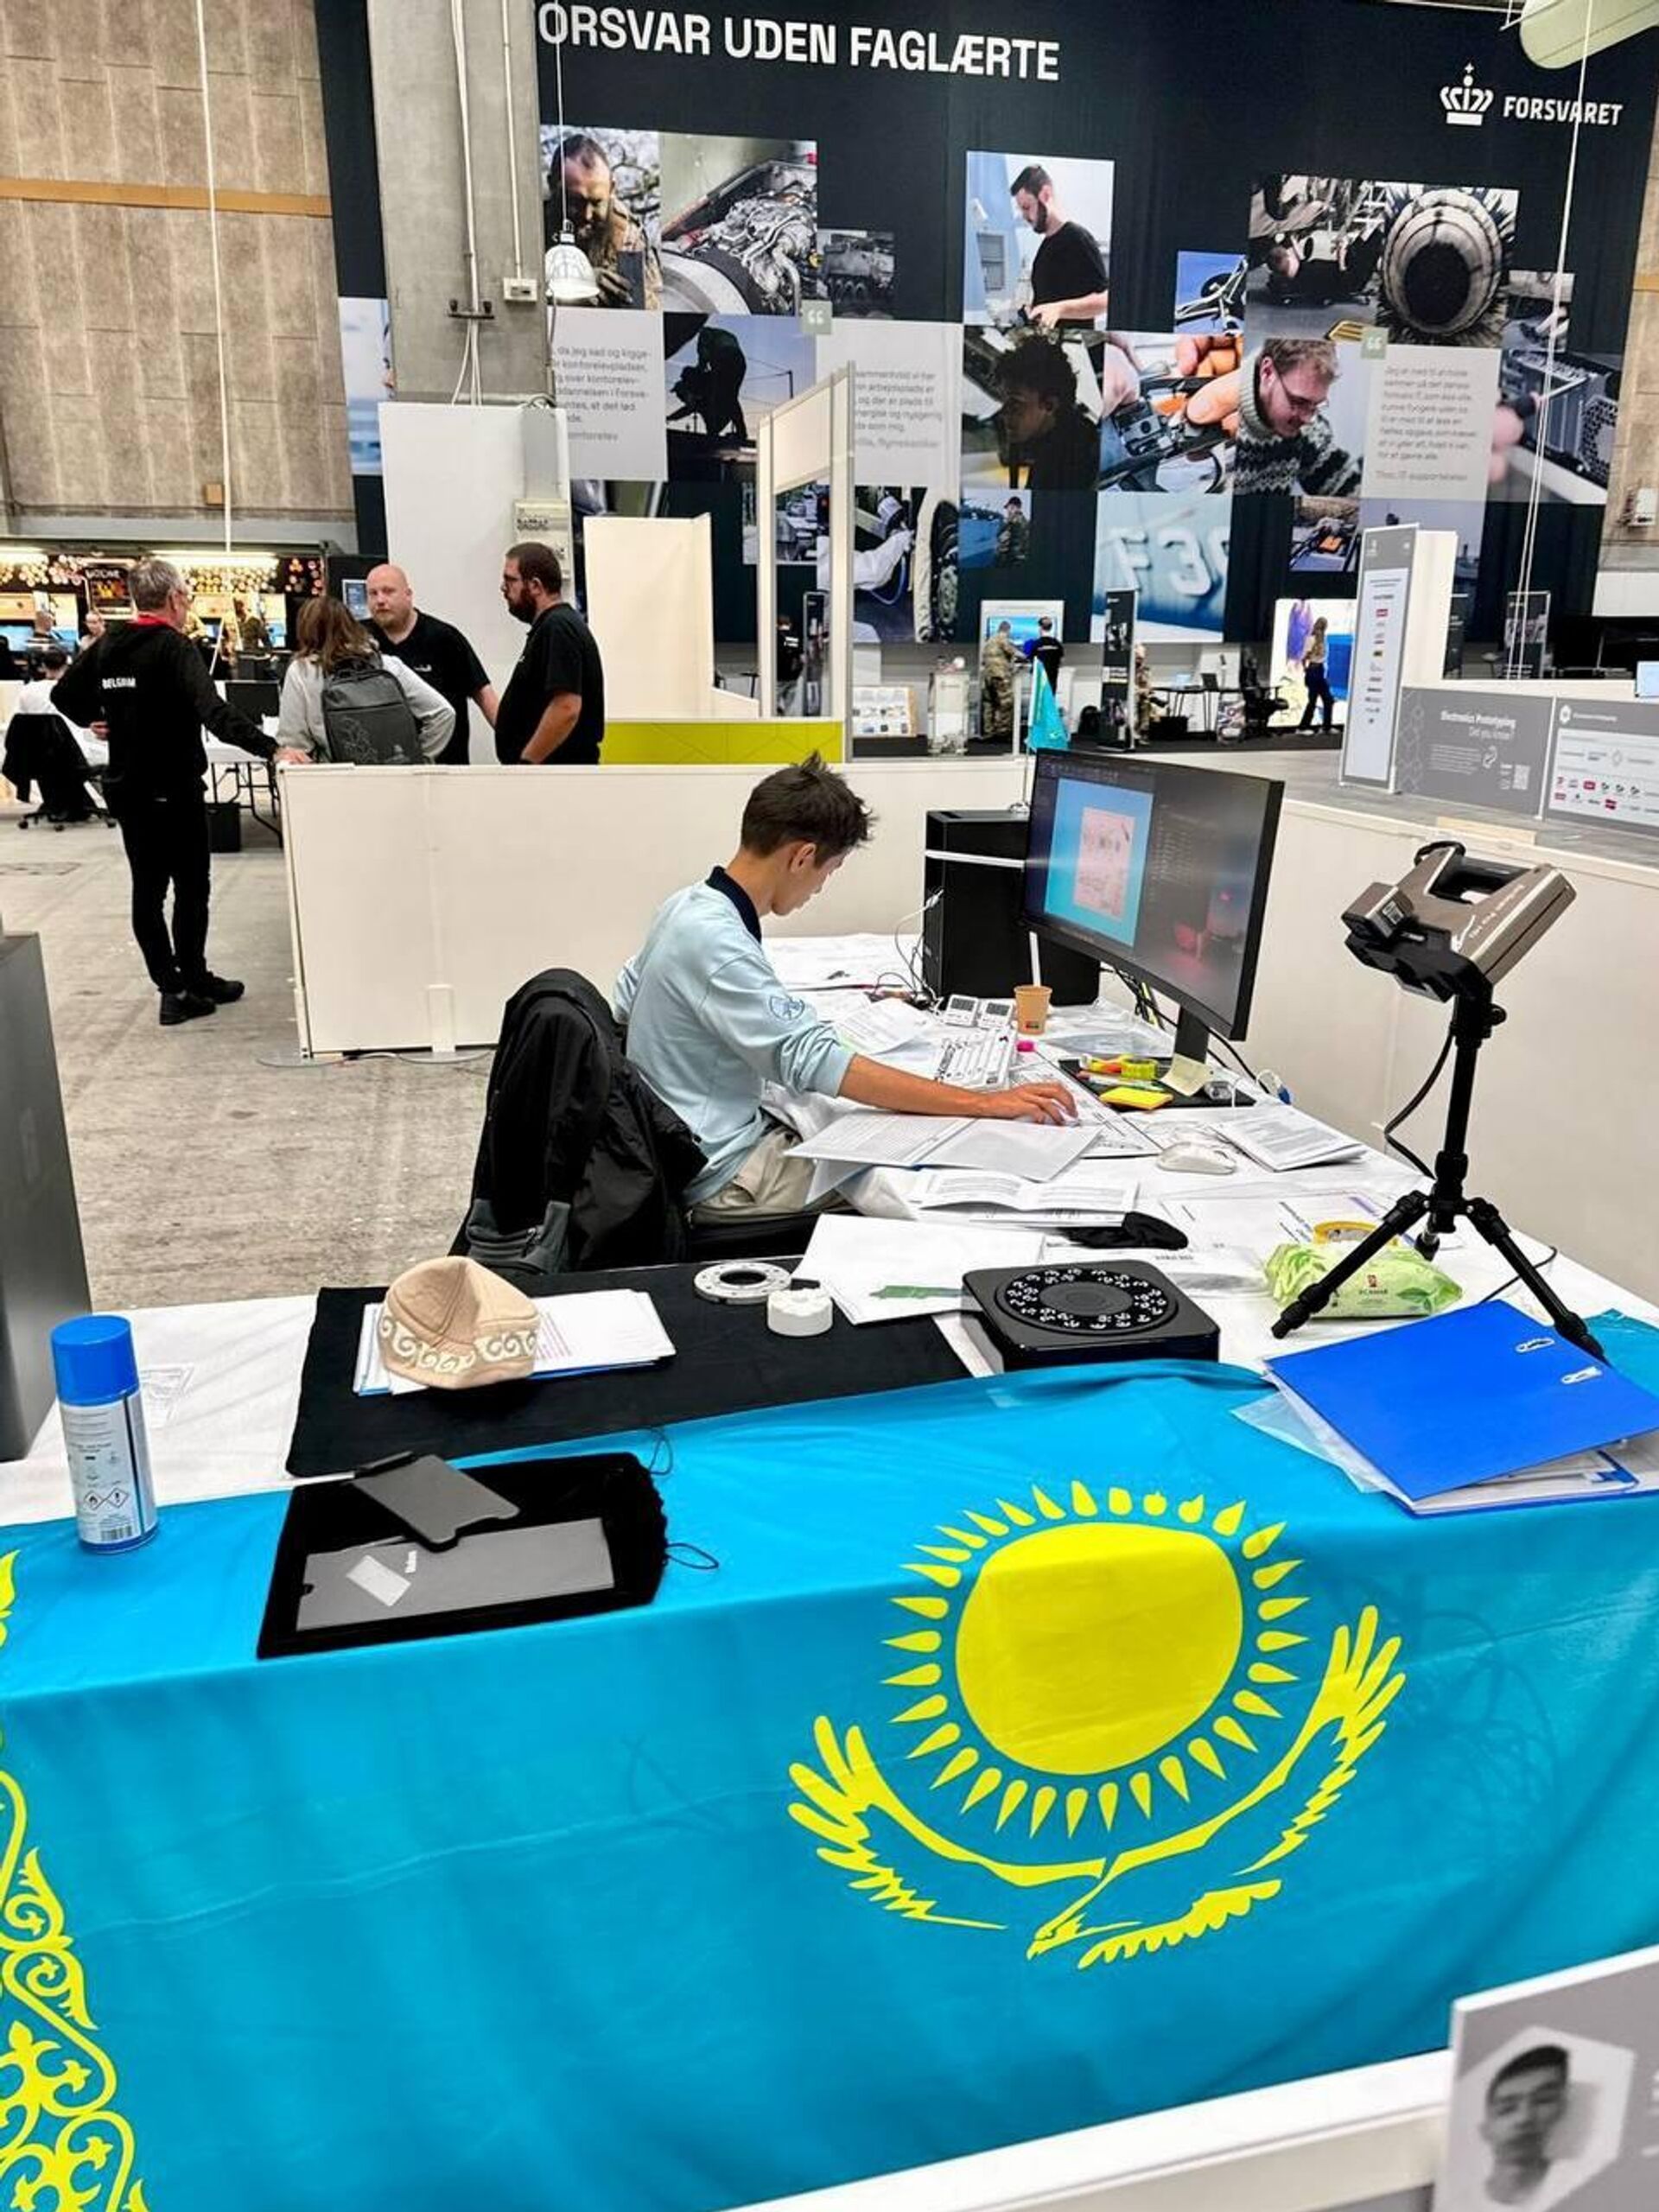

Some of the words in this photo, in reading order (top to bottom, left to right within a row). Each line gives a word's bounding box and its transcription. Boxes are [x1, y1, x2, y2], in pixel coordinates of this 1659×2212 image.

[537, 2, 710, 56] ORSVAR
[724, 17, 836, 66] UDEN
[850, 27, 1060, 82] FAGLÆRTE
[1503, 95, 1623, 126] FORSVARET
